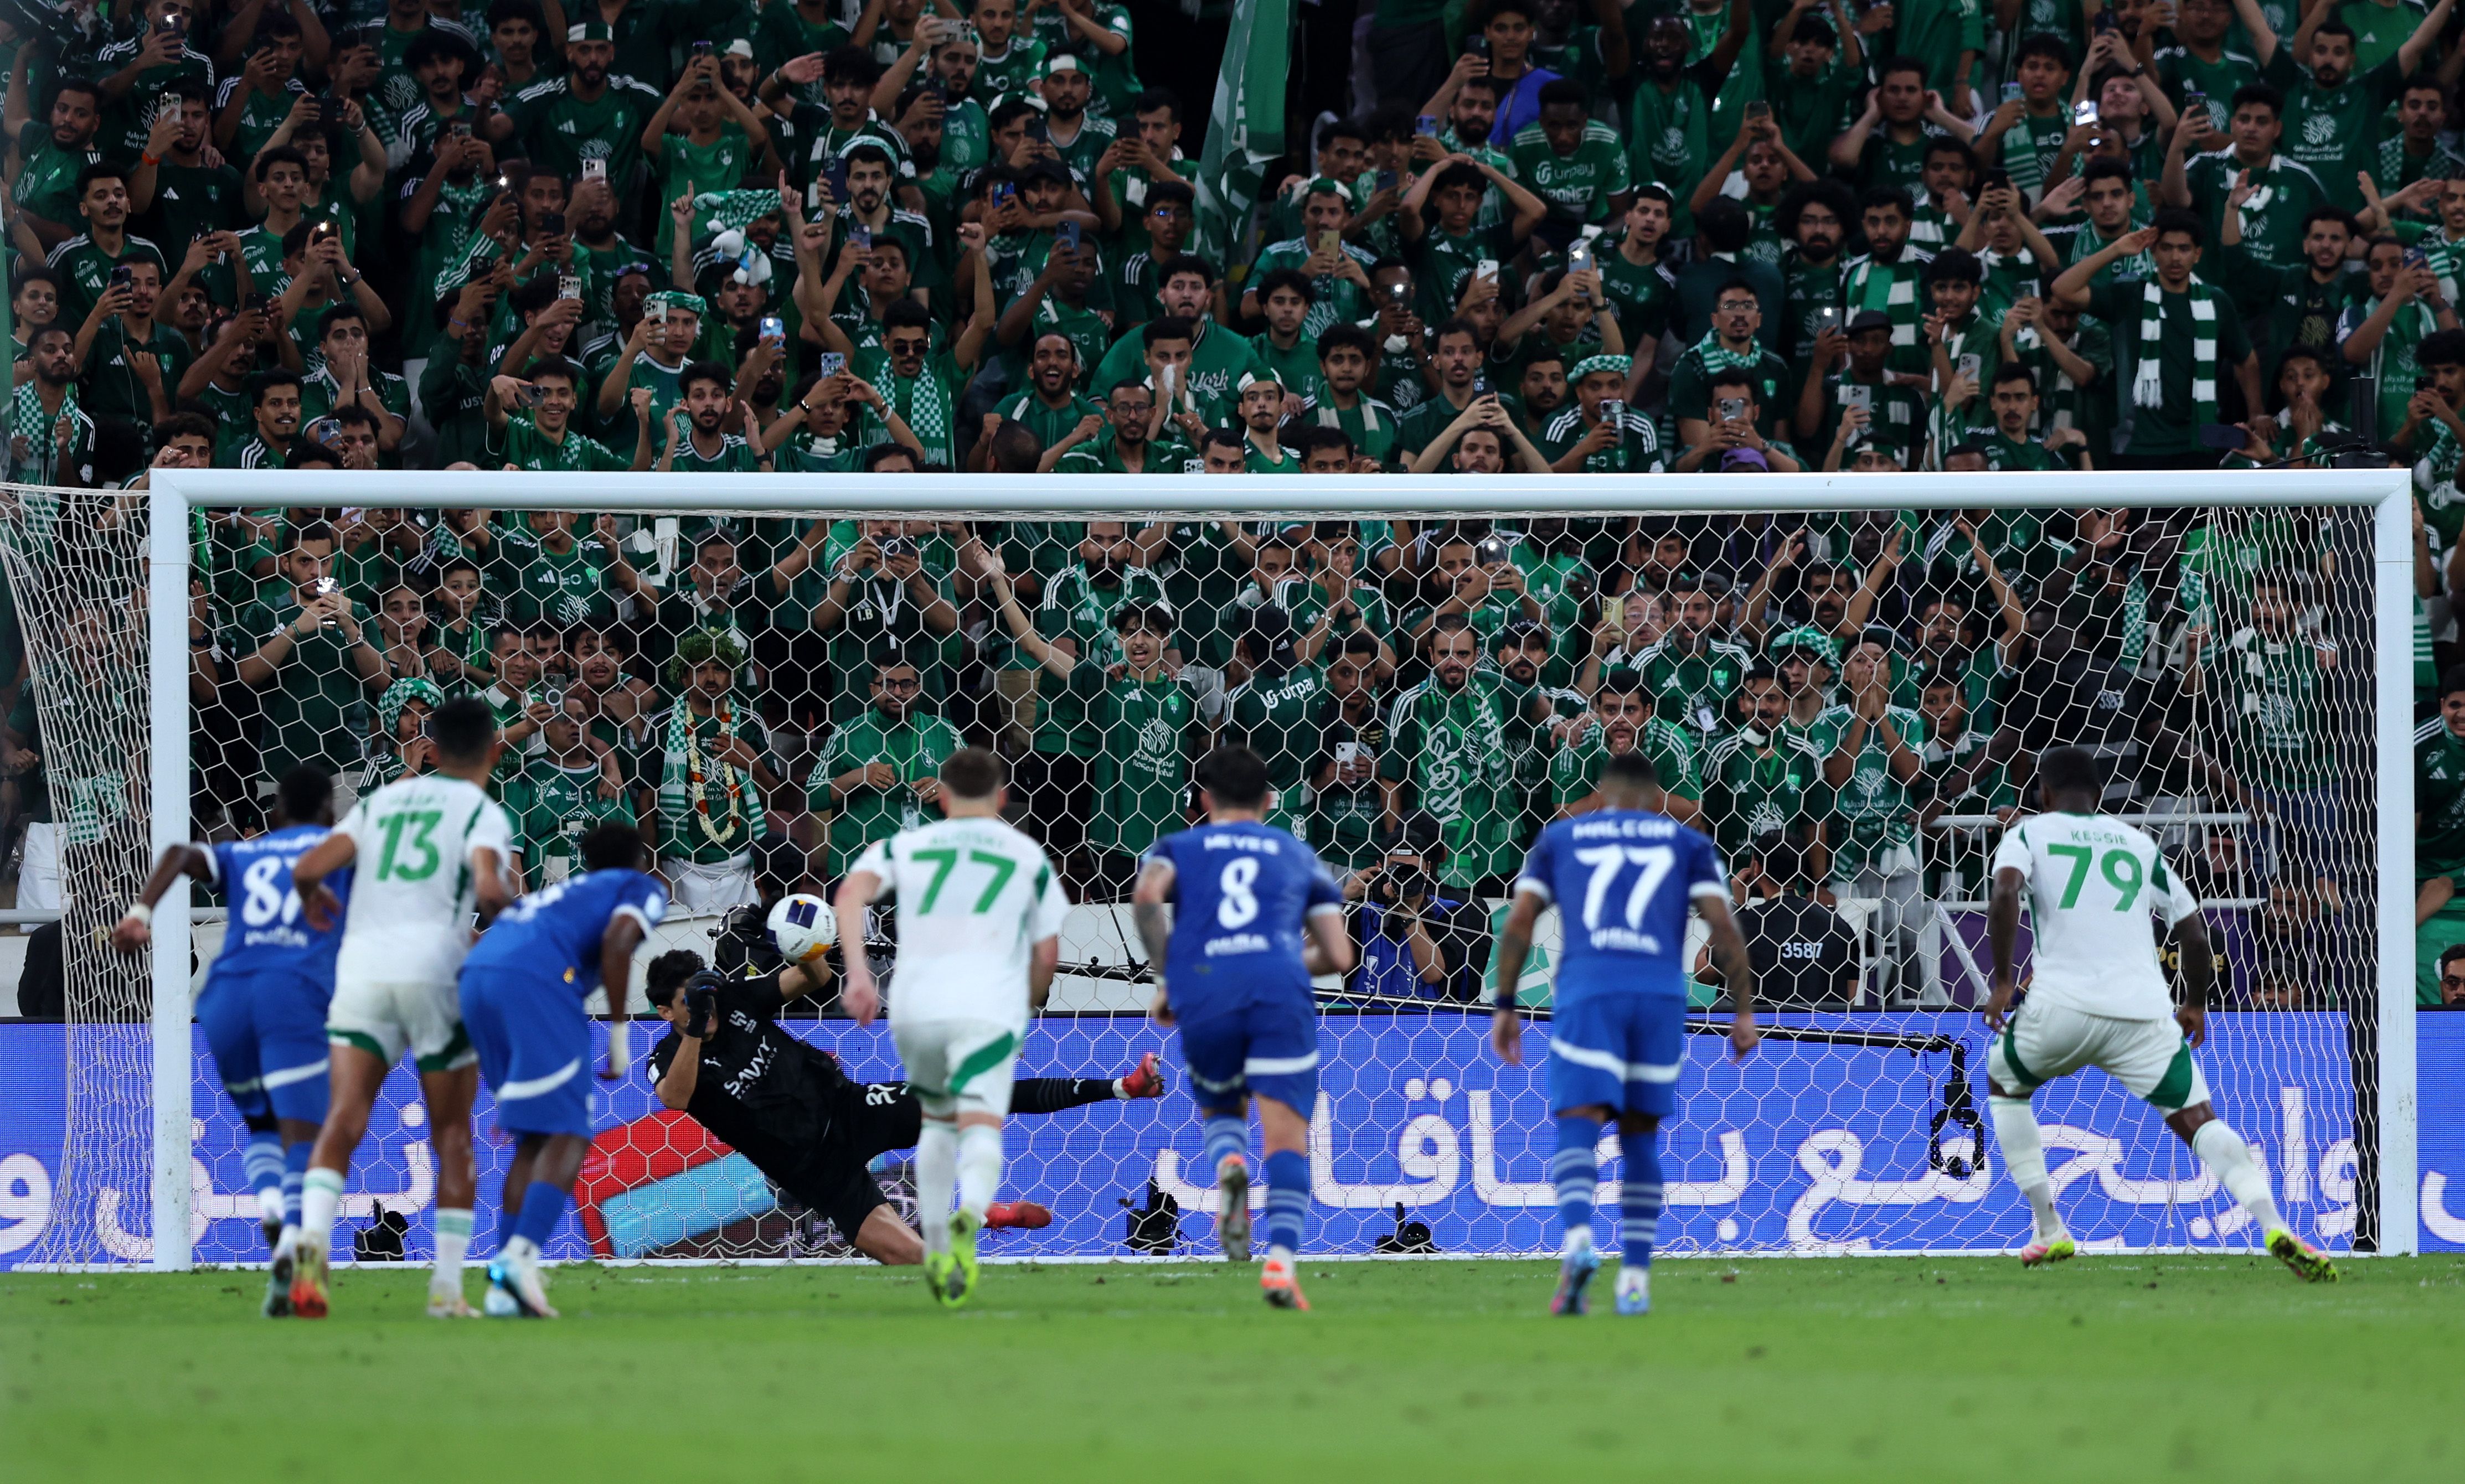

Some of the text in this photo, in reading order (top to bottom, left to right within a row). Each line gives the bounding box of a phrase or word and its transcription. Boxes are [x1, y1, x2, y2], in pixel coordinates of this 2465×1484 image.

[1280, 676, 1317, 700] urpay
[377, 810, 444, 881] 13
[2071, 830, 2129, 845] KESSIE
[910, 848, 1017, 916] 77
[1217, 856, 1260, 930] 8
[1574, 854, 1677, 930] 77
[2046, 842, 2143, 913] 79
[1781, 942, 1823, 959] 3587
[723, 1034, 771, 1096] SAVVY
[865, 1083, 897, 1106] 37
